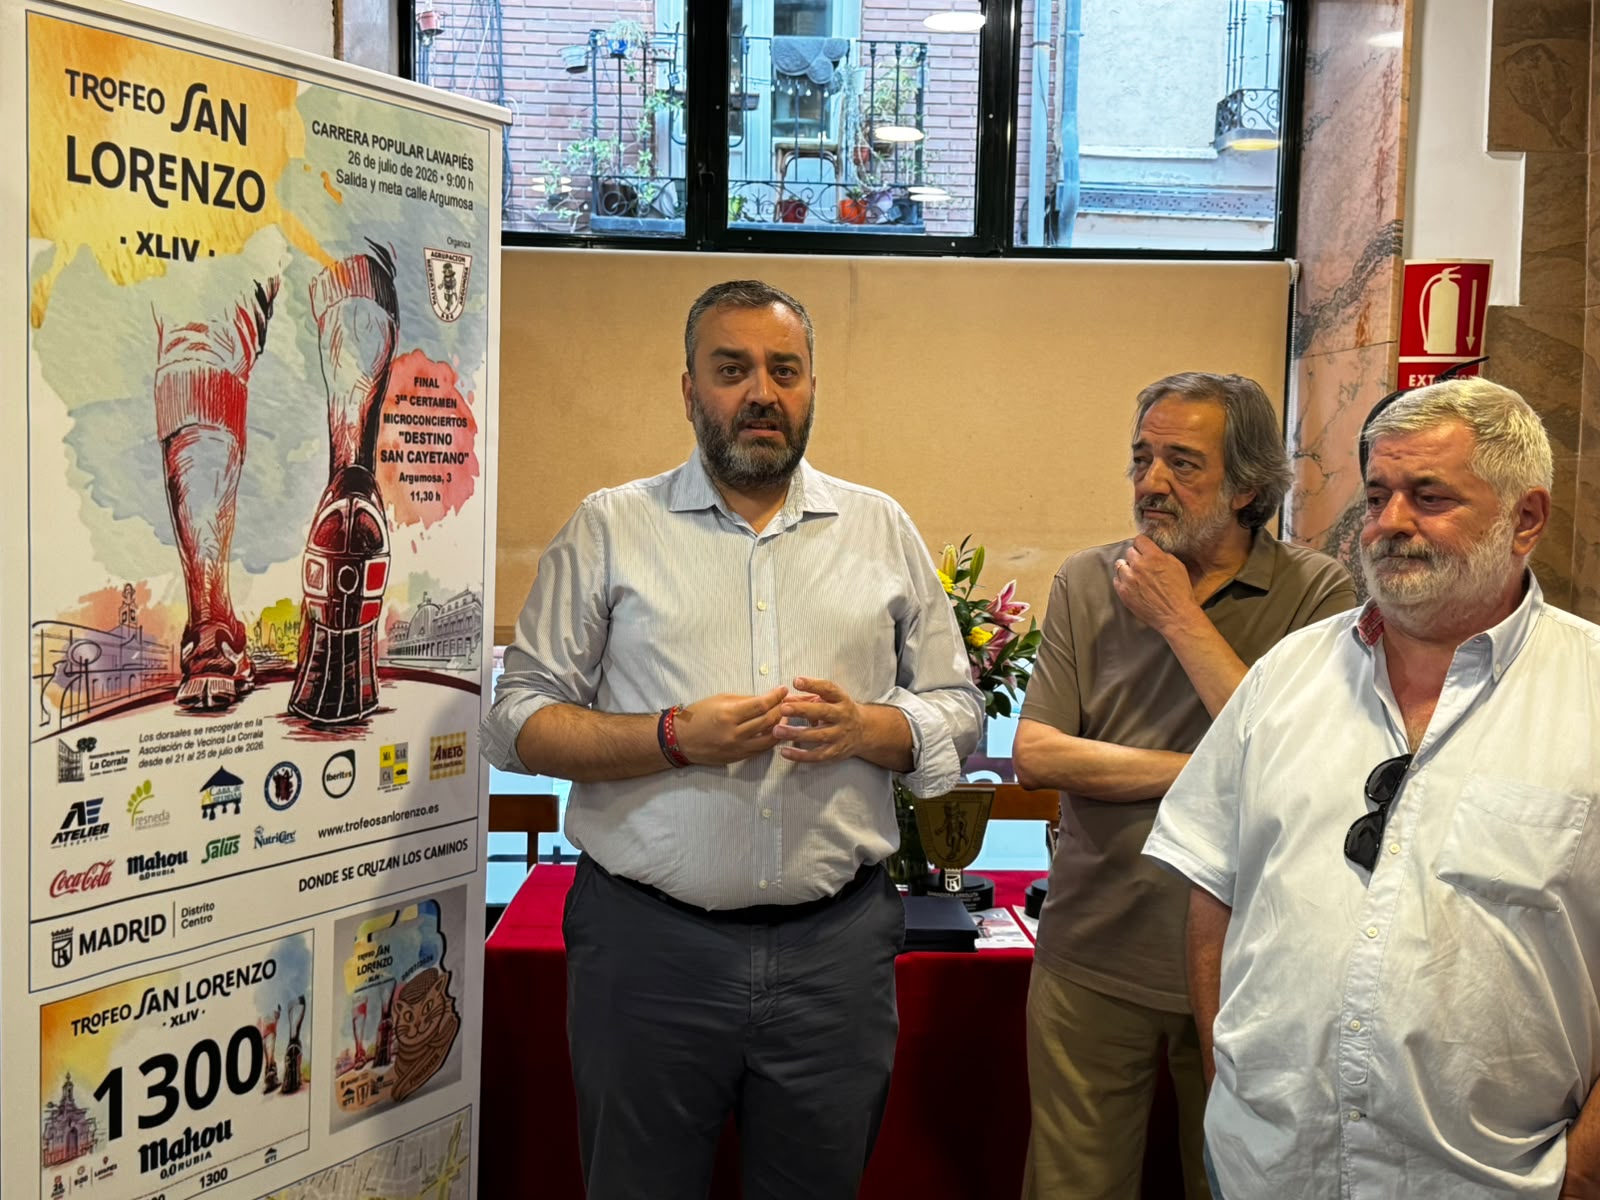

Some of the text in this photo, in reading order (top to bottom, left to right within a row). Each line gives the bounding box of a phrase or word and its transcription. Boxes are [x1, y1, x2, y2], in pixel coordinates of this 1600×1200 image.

[65, 68, 247, 146] TROFEO SAN
[311, 120, 474, 172] CARRERA POPULAR LAVAPIÉS
[66, 134, 265, 213] LORENZO
[347, 149, 474, 192] 26 de julio de 2026 9:00 h
[336, 168, 474, 211] Salida y meta calle Argumosa
[136, 230, 200, 262] XLIV
[414, 377, 440, 388] FINAL
[409, 395, 457, 409] CERTAMEN
[383, 413, 468, 428] MICROCONCIERTOS
[398, 431, 453, 446] "DESTINO
[380, 449, 470, 465] SAN CAYETANO"
[399, 471, 452, 484] Argumosa, 3
[410, 491, 441, 503] 11,30 h
[138, 741, 183, 756] Asociación
[184, 740, 195, 750] de
[197, 736, 225, 747] Vecinos
[226, 734, 236, 743] La
[238, 730, 264, 741] Corrala
[139, 718, 263, 743] Los dorsales se recogerán en la
[90, 756, 128, 770] La Corrala
[139, 740, 264, 768] desde el 21 al 25 de julio de 2026
[50, 823, 110, 845] ATELIER
[318, 804, 439, 839] www.trofeosanlorenzo.es
[201, 833, 240, 864] Salus
[127, 850, 188, 876] Mahou
[151, 868, 175, 878] RUBIA
[298, 838, 468, 892] DONDE SE CRUZAN LOS CAMINOS
[181, 901, 215, 918] Distrito
[181, 914, 213, 930] Centro
[79, 913, 166, 956] MADRID
[375, 944, 390, 959] SAN
[357, 956, 393, 976] LORENZO
[71, 958, 277, 1036] TROFEO SAN LORENZO
[93, 1024, 264, 1141] 1300
[138, 1119, 232, 1174] Mahou
[178, 1150, 212, 1172] RUBIA
[200, 1167, 228, 1189] 1300
